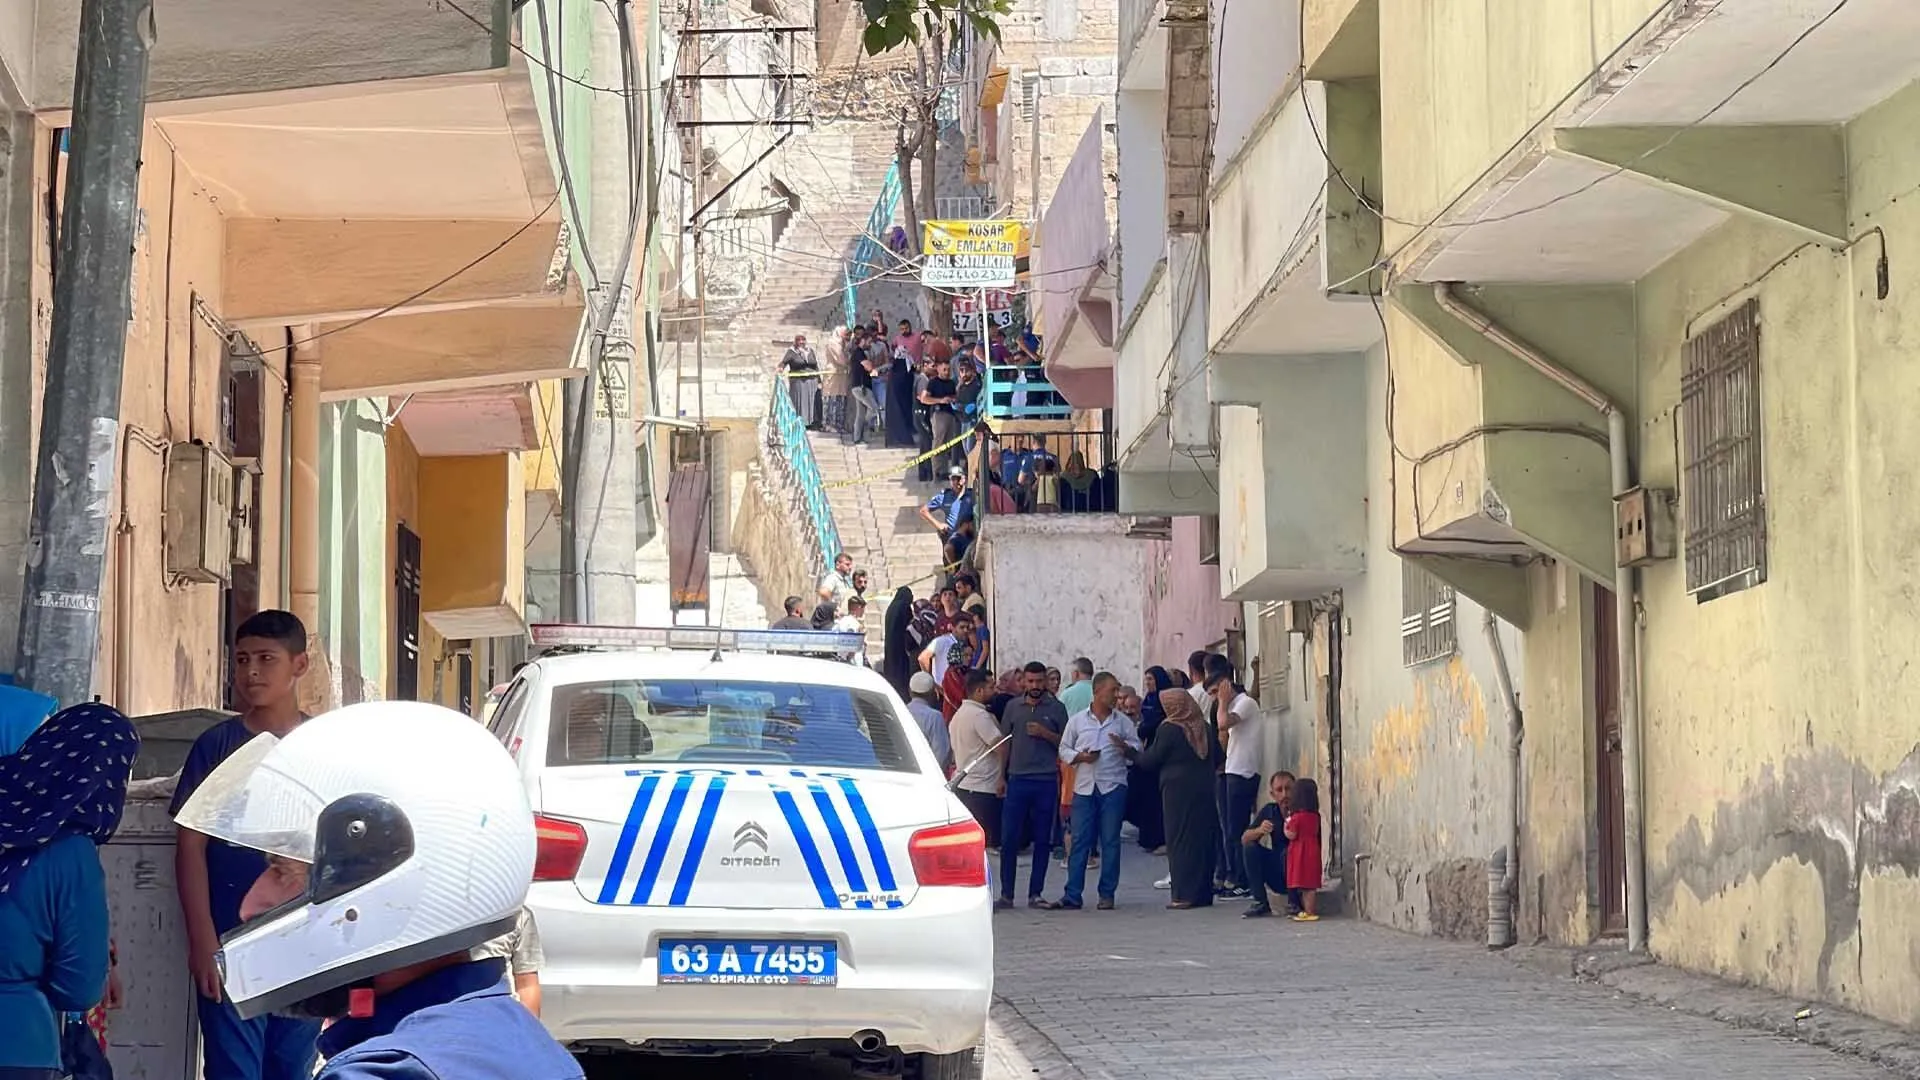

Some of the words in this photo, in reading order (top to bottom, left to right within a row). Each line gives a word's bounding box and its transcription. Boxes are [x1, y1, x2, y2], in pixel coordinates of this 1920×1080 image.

[671, 944, 709, 973] 63
[718, 944, 742, 973] A
[750, 945, 825, 974] 7455
[763, 974, 789, 984] OTO
